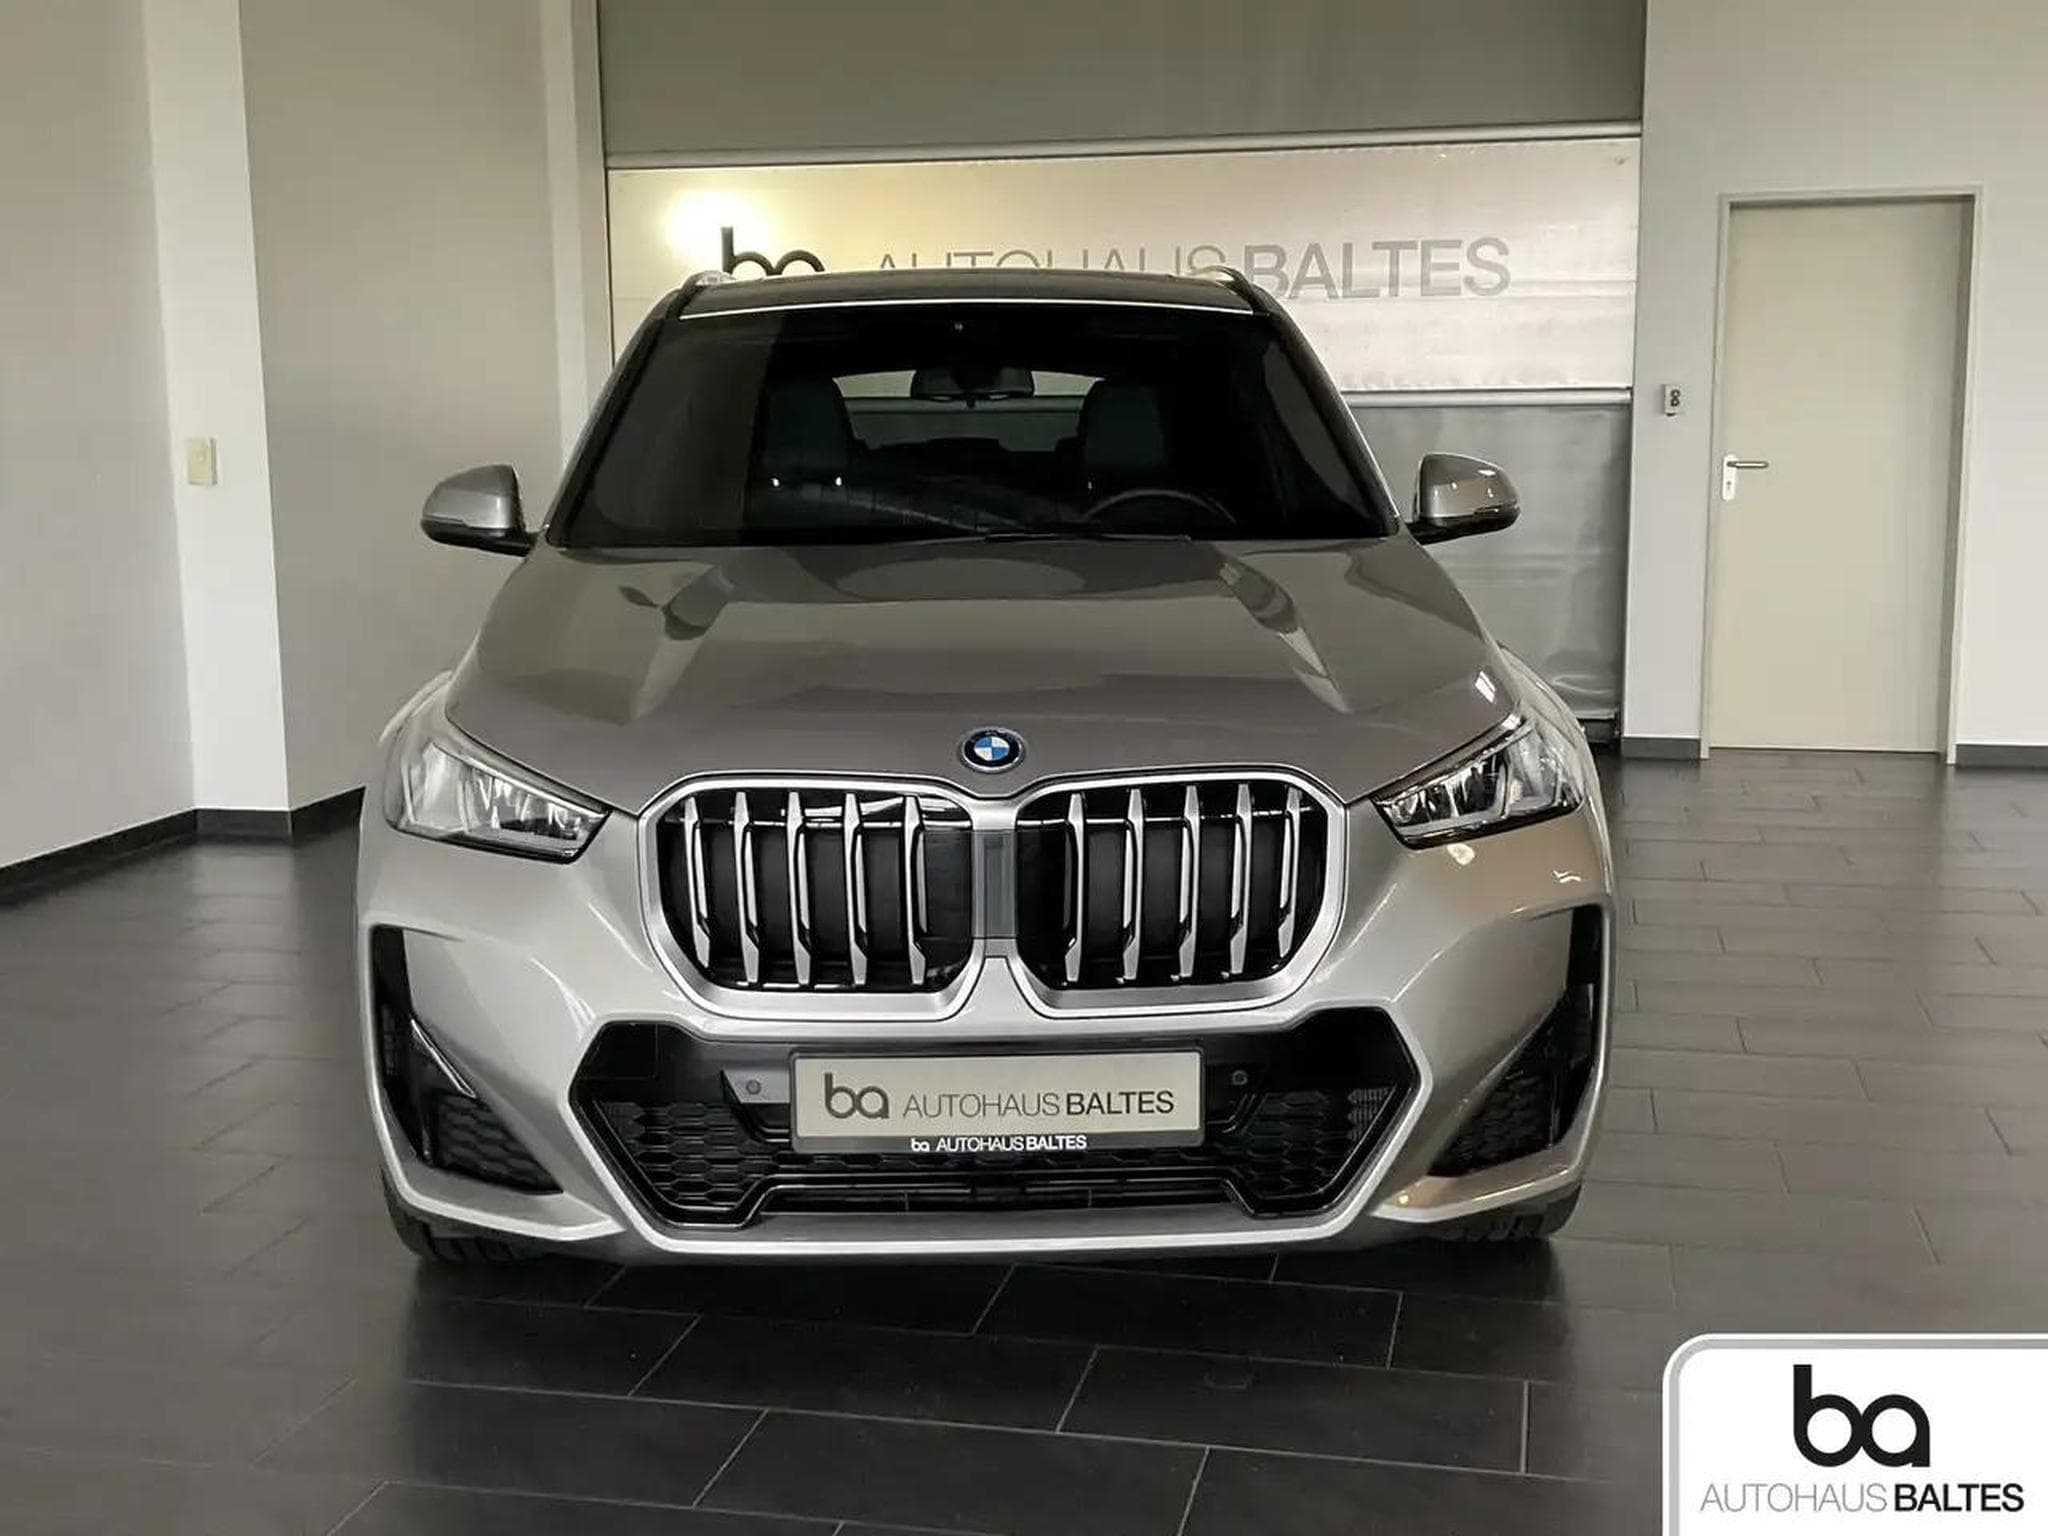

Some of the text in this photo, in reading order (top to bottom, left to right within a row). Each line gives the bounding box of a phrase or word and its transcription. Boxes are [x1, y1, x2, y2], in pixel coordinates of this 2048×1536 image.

[1243, 237, 1511, 299] BALTES
[824, 1073, 1175, 1119] ba AUTOHAUS BALTES
[911, 1135, 1087, 1152] ba AUTOHAUS BALTES
